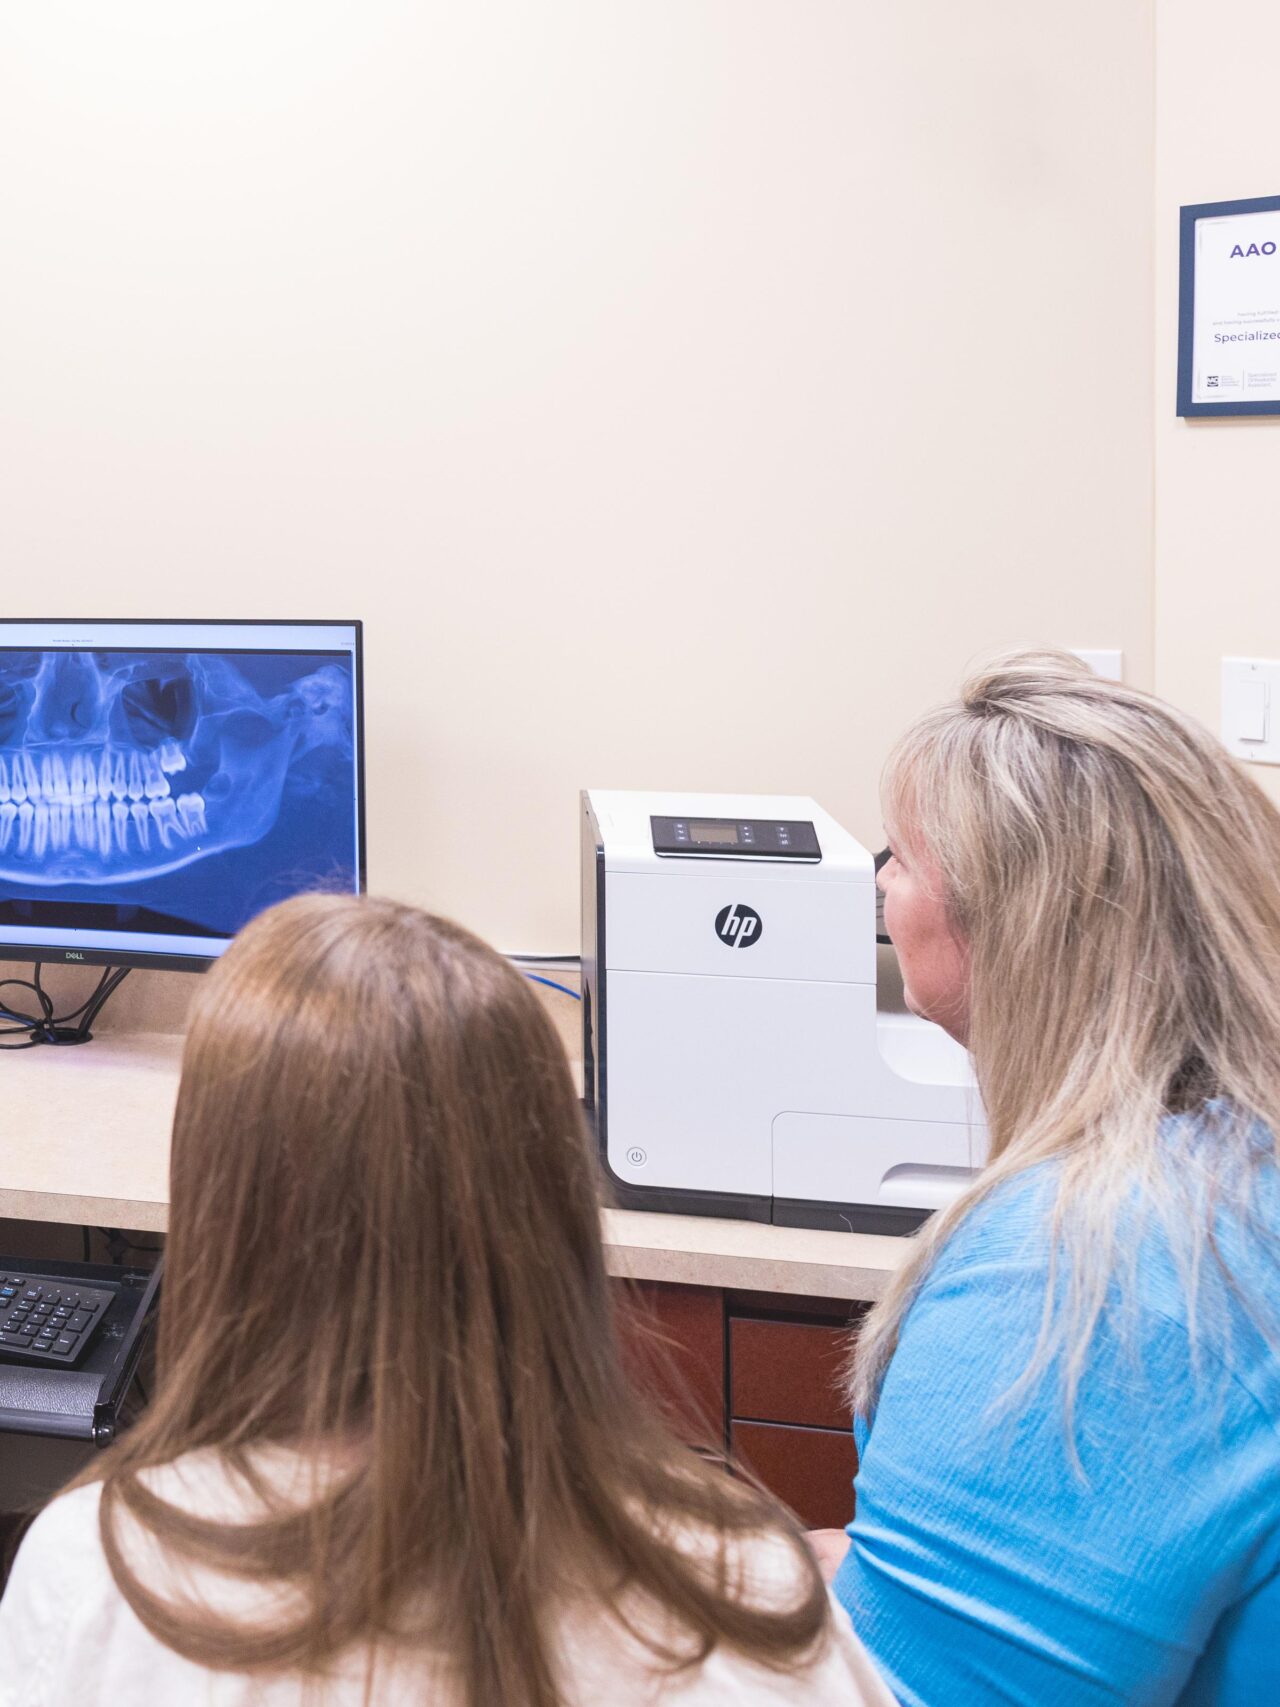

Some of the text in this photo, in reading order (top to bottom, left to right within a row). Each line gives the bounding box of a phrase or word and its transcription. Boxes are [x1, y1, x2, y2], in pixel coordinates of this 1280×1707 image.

[1230, 241, 1277, 258] AAO
[719, 904, 759, 948] hp
[65, 952, 85, 960] DELL
